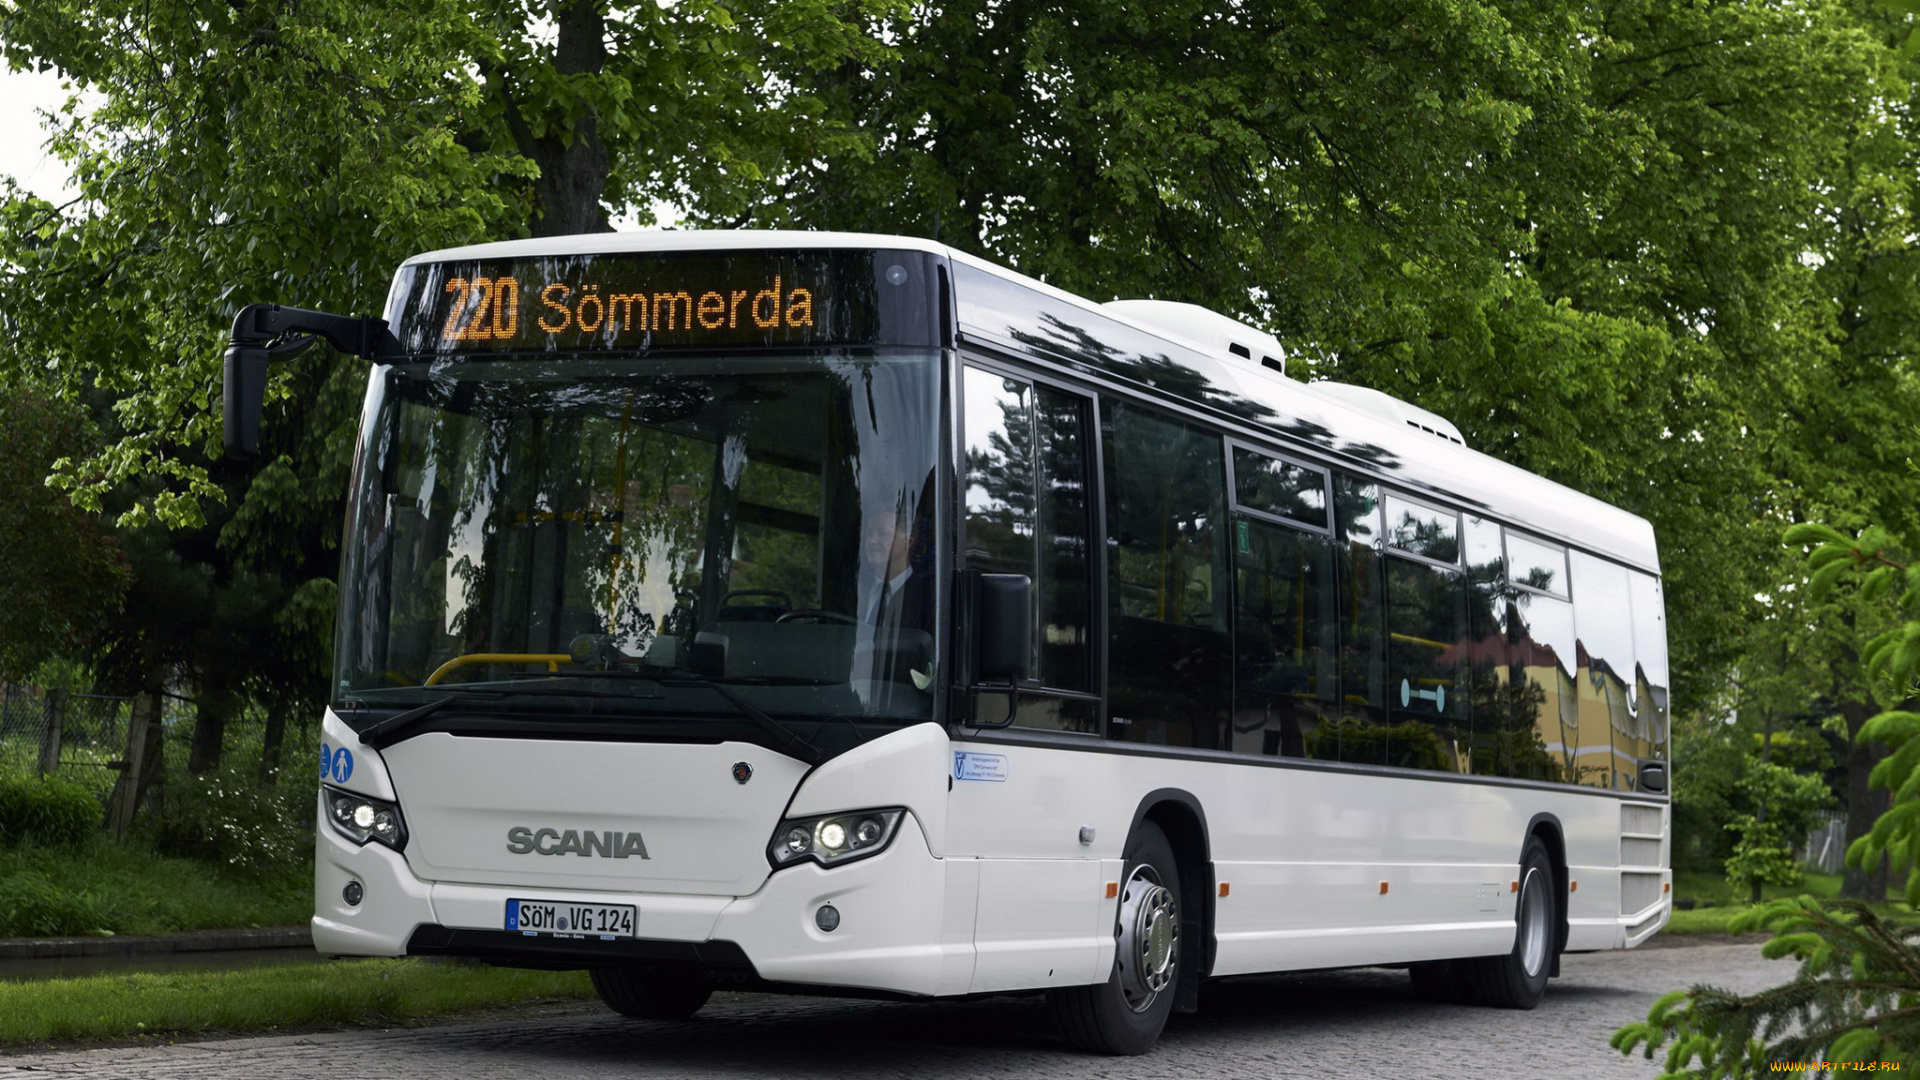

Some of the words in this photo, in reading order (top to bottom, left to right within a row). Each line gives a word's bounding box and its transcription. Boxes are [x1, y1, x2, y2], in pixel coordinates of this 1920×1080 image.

[443, 276, 518, 340] 220
[538, 274, 813, 333] Sömmerda
[507, 826, 650, 860] SCANIA
[510, 917, 515, 925] D
[570, 907, 593, 931] VG
[597, 909, 631, 933] 124
